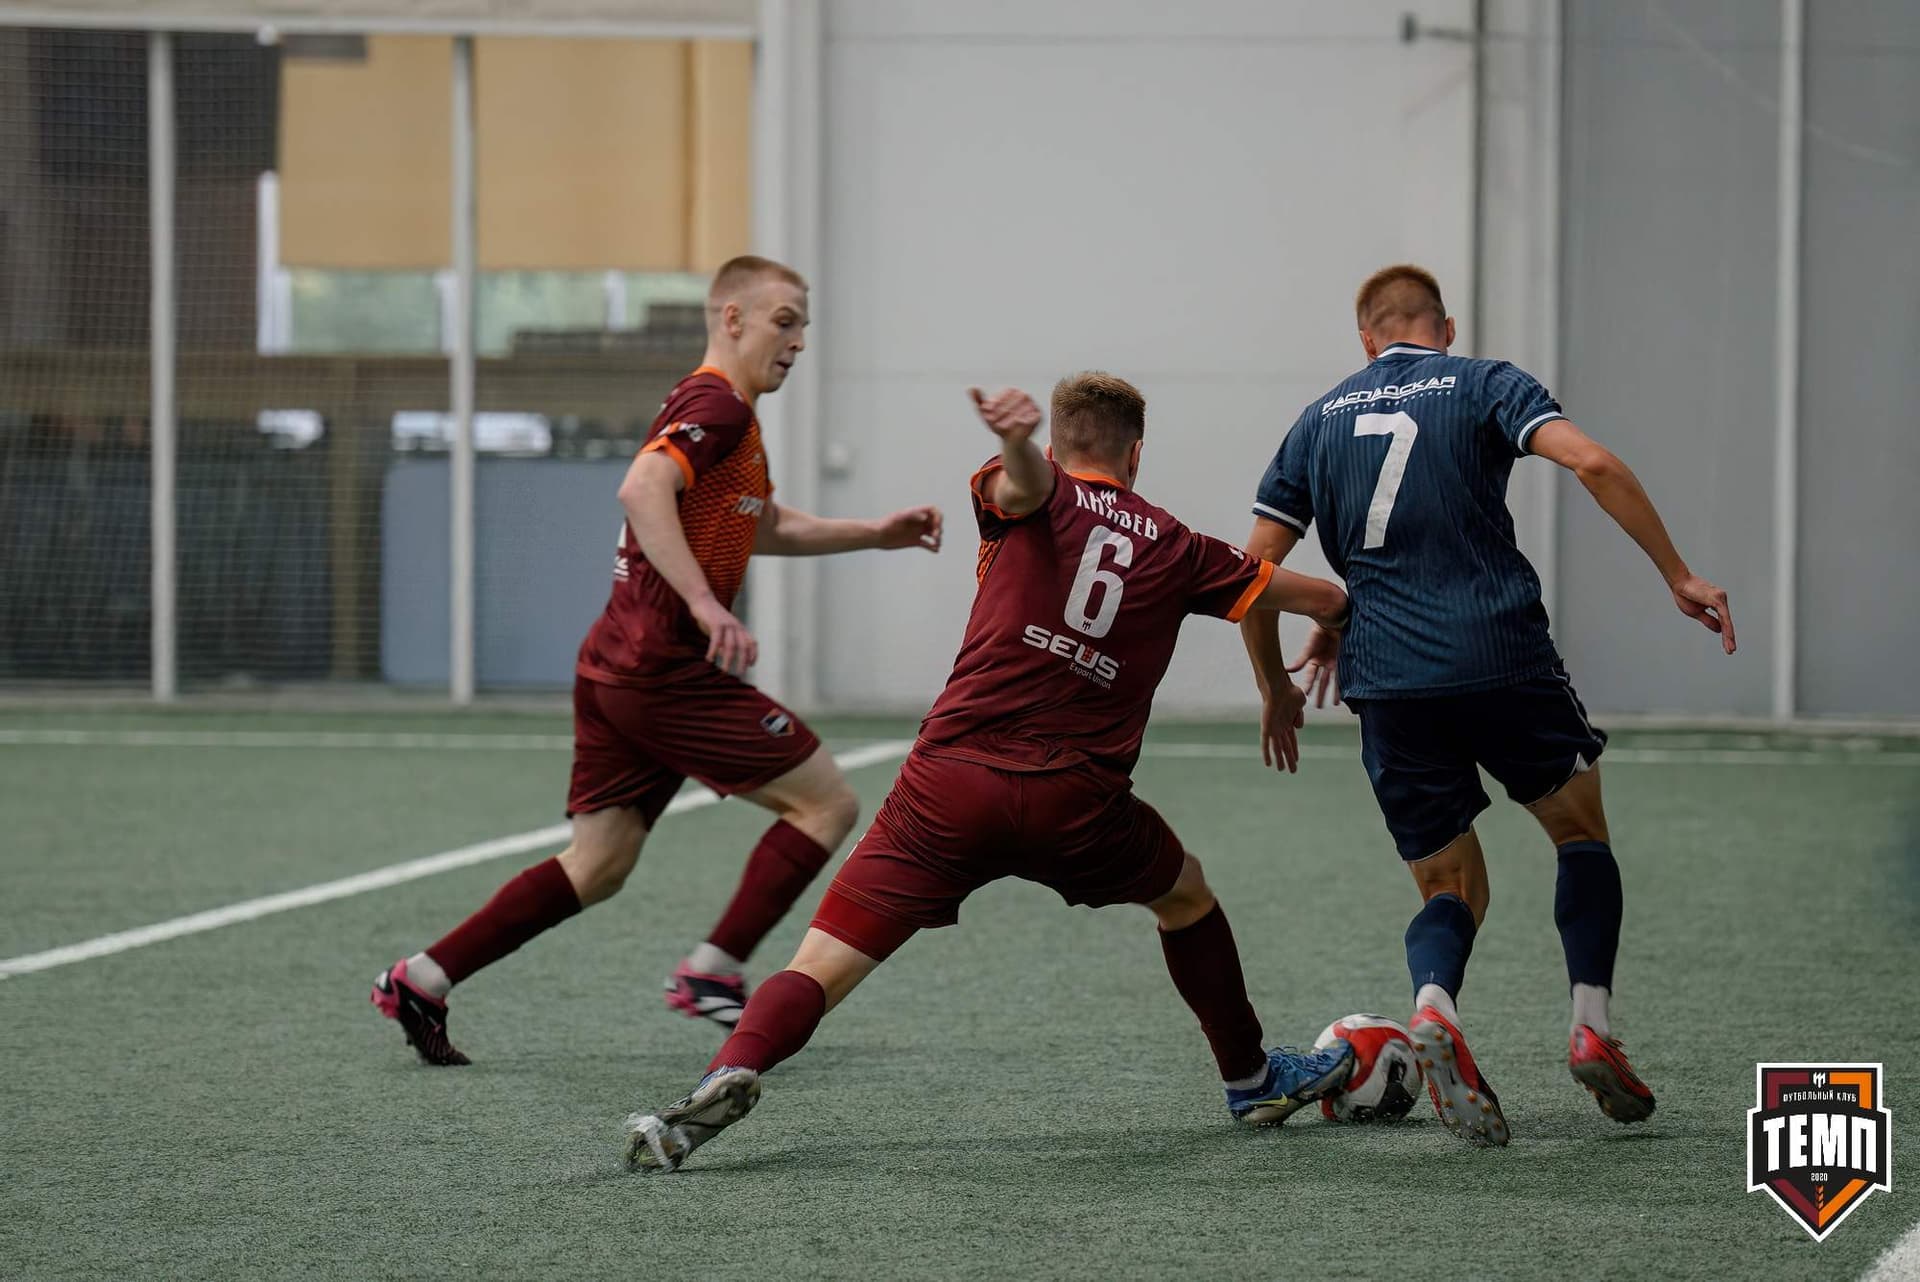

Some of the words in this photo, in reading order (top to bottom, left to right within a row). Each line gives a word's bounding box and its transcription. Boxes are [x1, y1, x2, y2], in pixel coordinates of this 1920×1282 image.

[1353, 411, 1418, 550] 7
[1064, 525, 1134, 638] 6
[1022, 624, 1119, 681] SEUS
